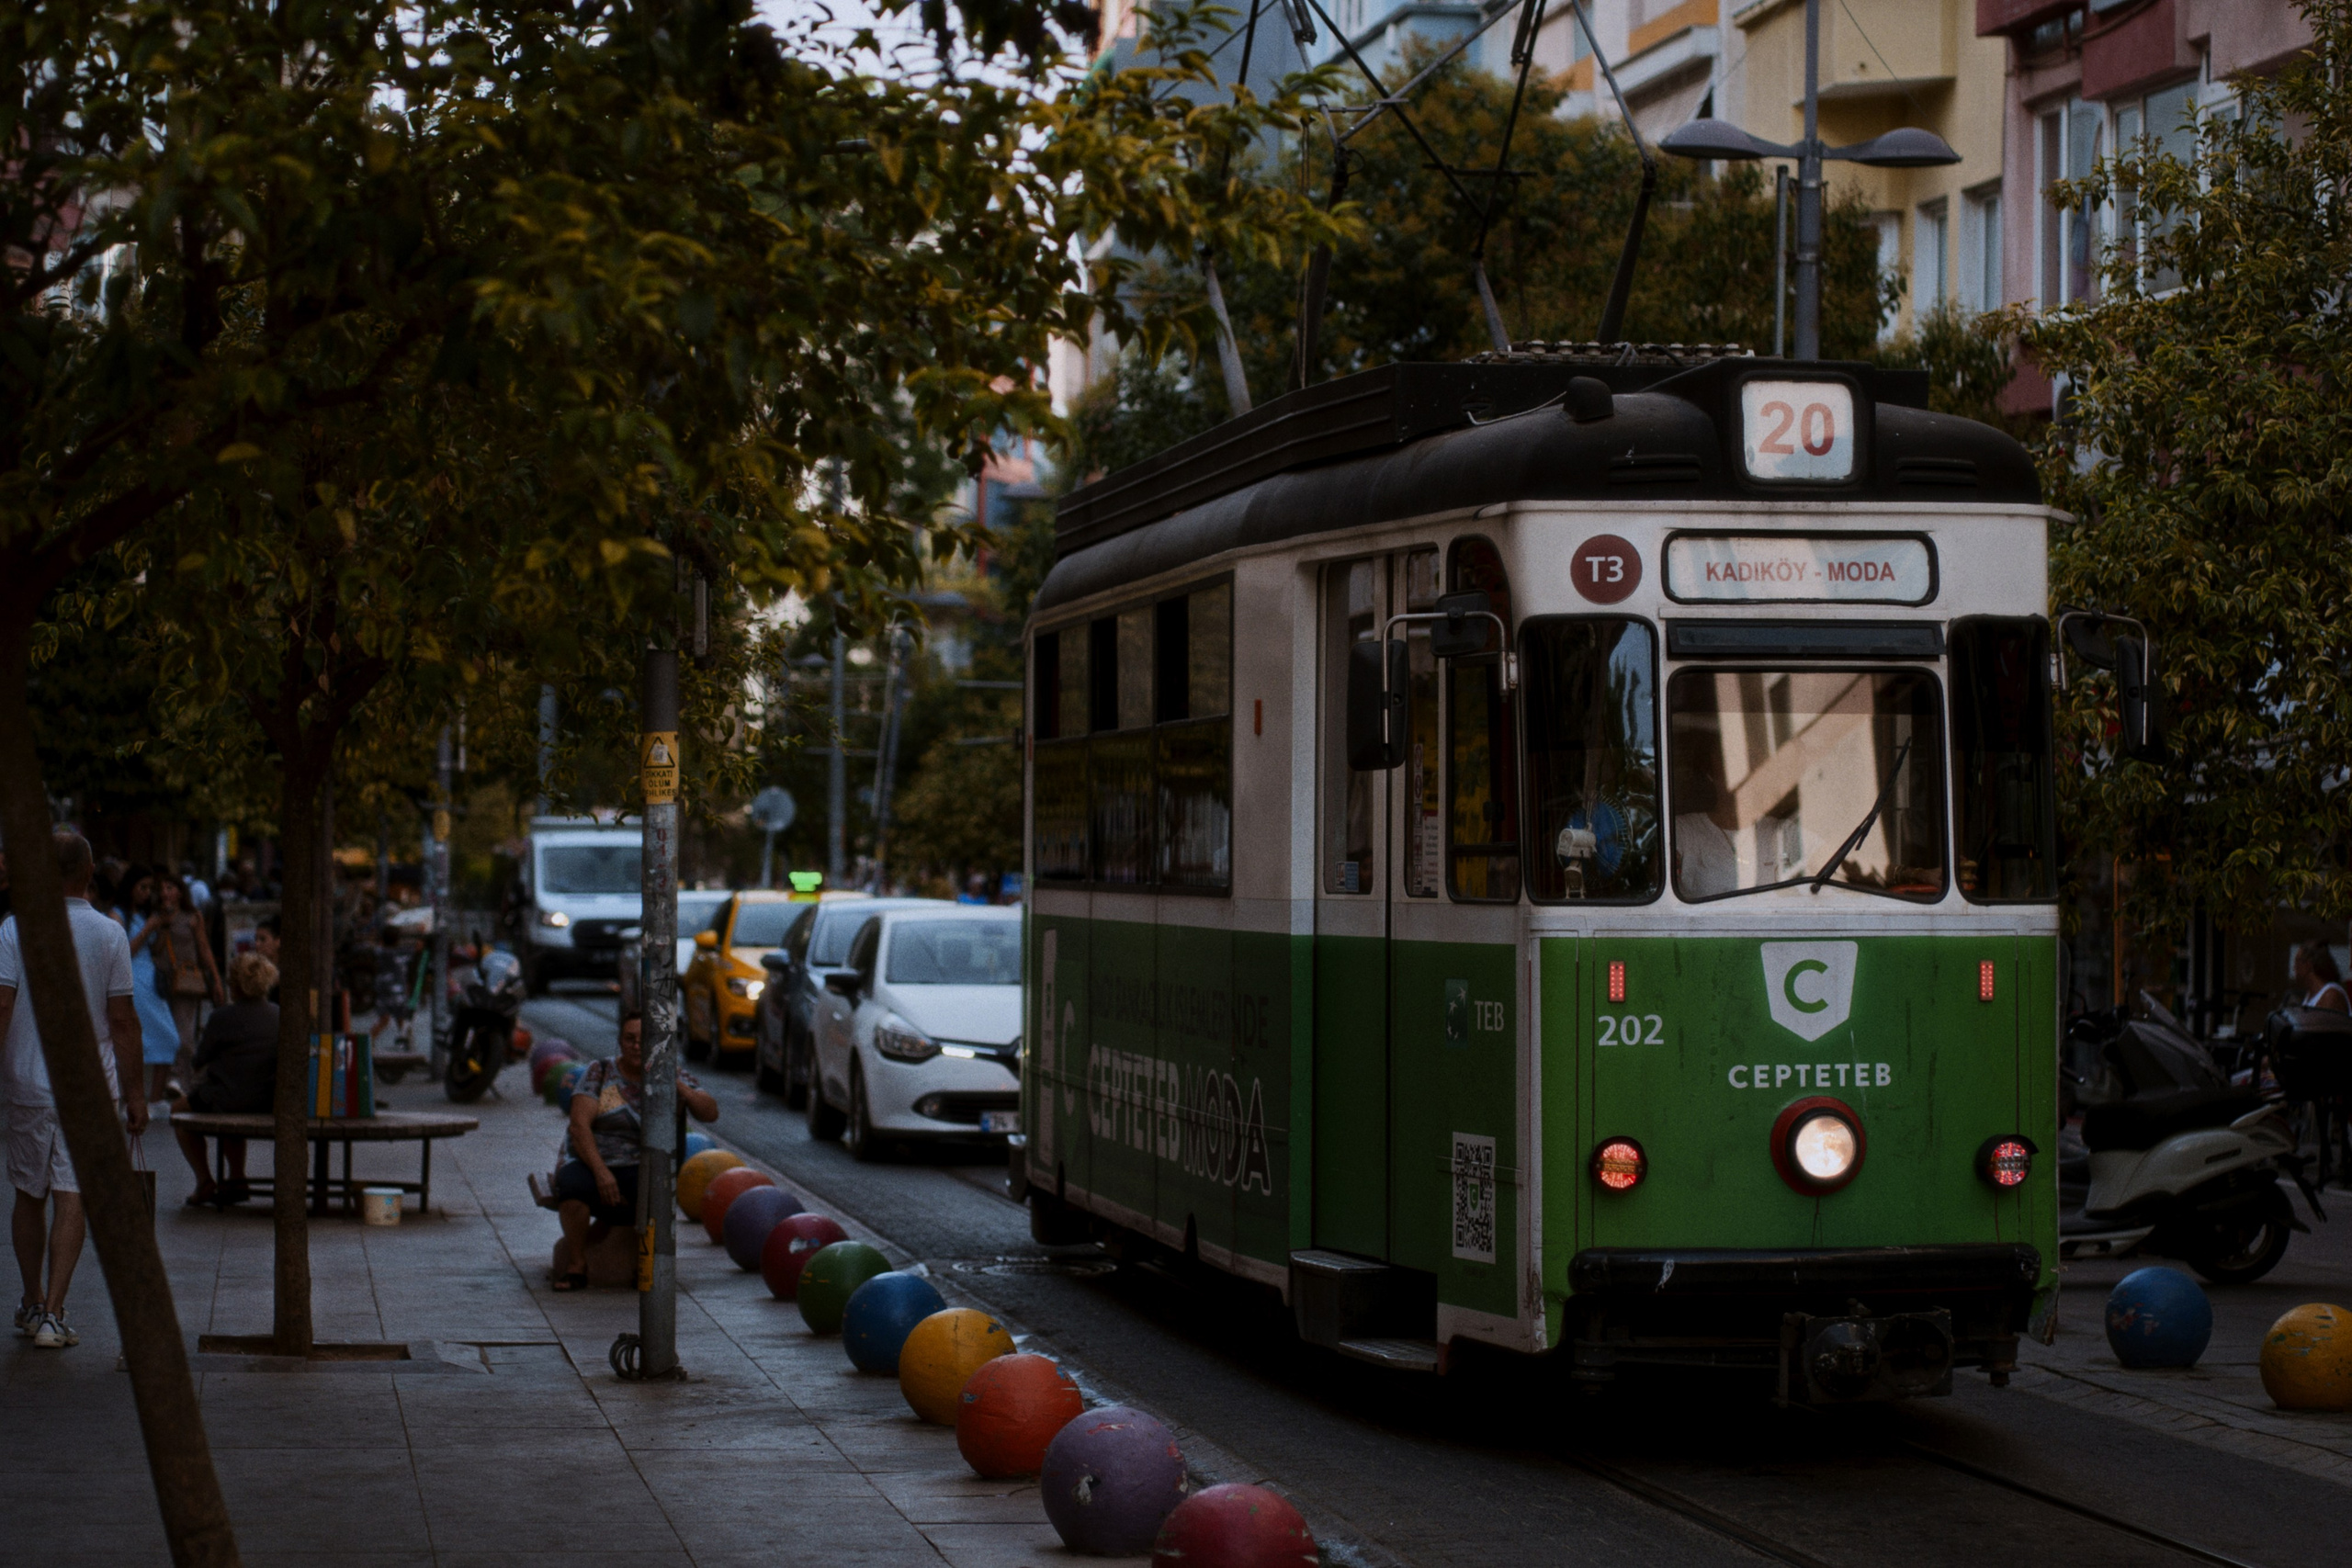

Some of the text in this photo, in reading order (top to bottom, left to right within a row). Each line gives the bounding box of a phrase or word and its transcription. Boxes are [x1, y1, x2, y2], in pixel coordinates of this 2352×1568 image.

[1758, 400, 1836, 457] 20
[1585, 556, 1624, 583] T3
[1706, 556, 1806, 582] KADIKÖY
[1828, 562, 1895, 582] MODA
[1783, 959, 1829, 1013] C
[1474, 999, 1505, 1032] TEB
[1598, 1015, 1665, 1046] 202
[1727, 1062, 1892, 1089] CEPTETEB
[1088, 1043, 1272, 1196] CEPTETEB MODA
